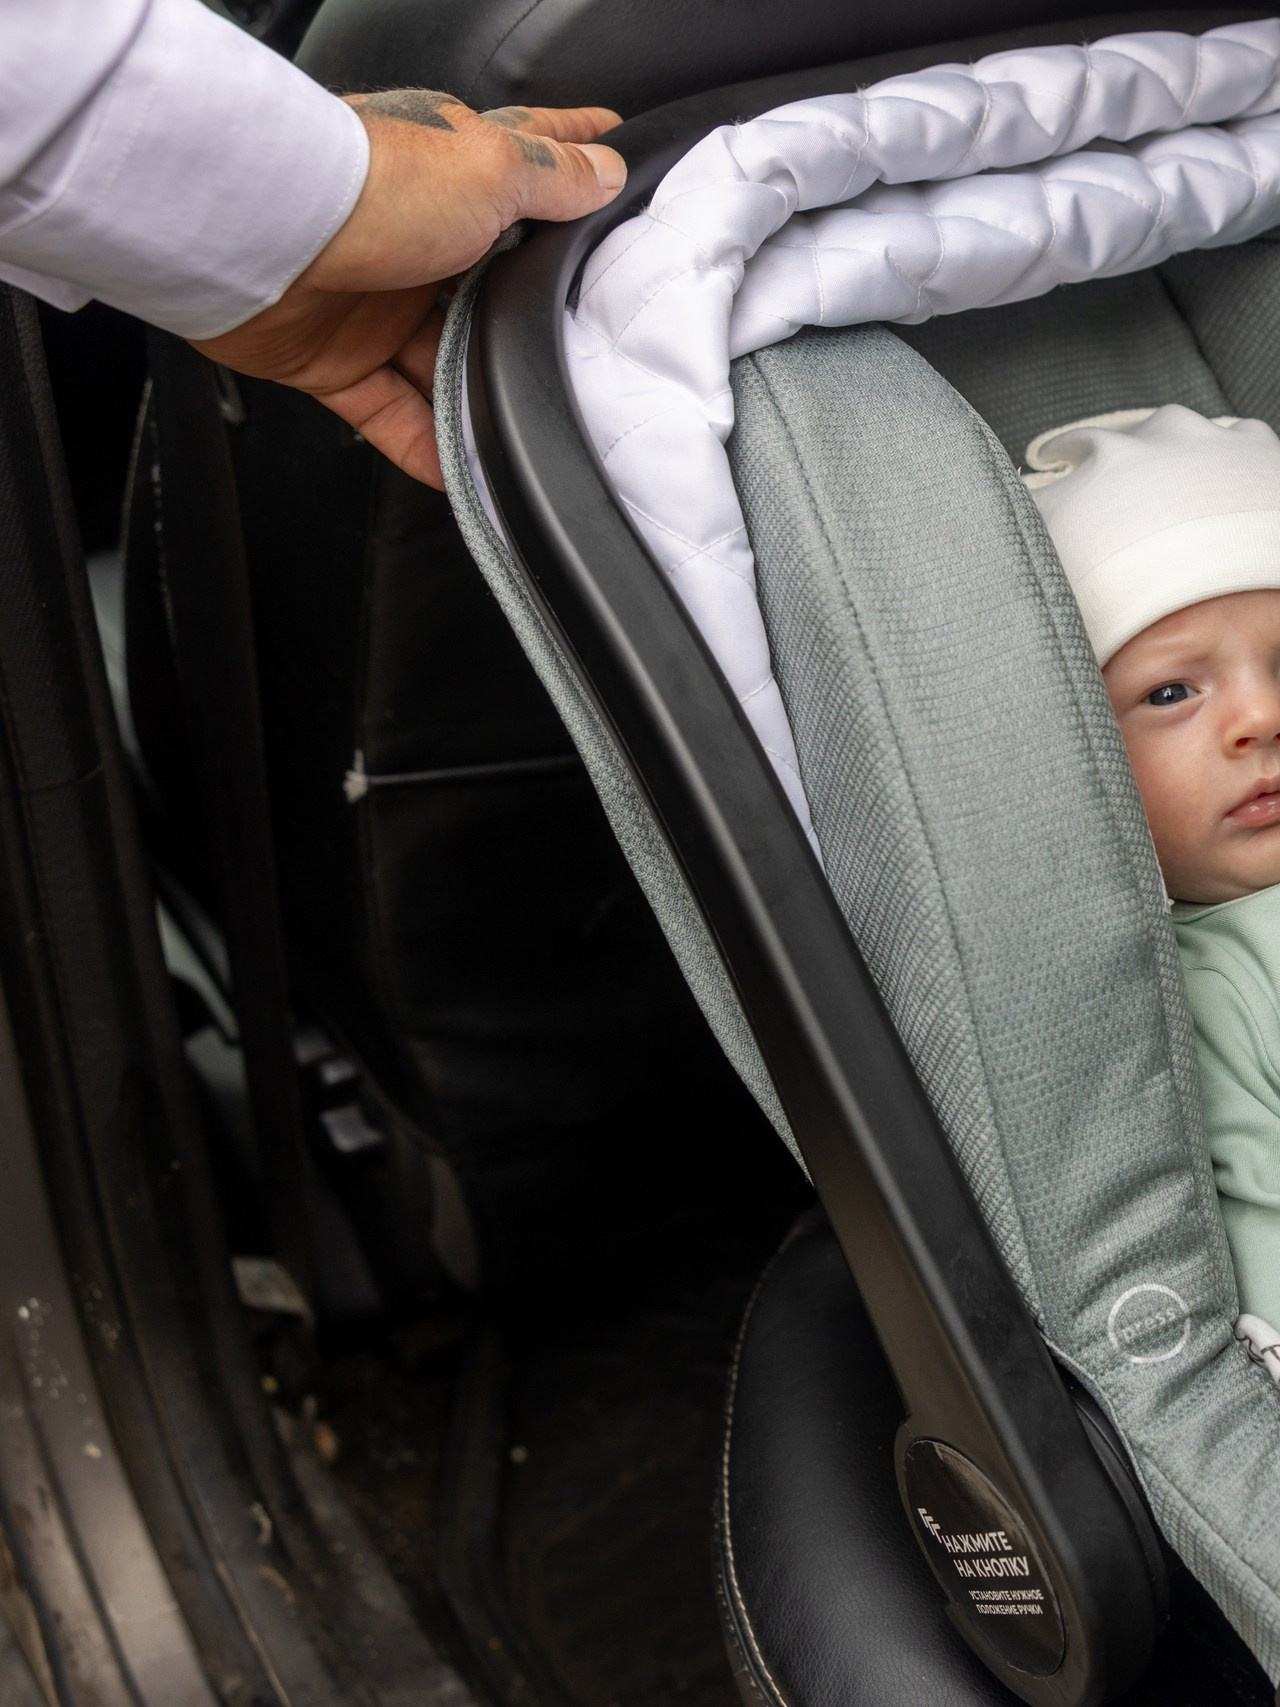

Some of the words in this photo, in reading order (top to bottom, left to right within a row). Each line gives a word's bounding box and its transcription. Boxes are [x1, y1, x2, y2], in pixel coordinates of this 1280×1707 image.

[941, 1531, 1013, 1553] НАЖМИТЕ
[953, 1559, 976, 1578] НА
[974, 1556, 1030, 1578] КНОПКУ
[968, 1590, 1013, 1601] УСТАНОВИТЕ
[1011, 1588, 1044, 1601] НУЖНОЕ
[976, 1604, 1020, 1615] ПОЛОЖЕНИЕ
[1018, 1604, 1044, 1615] РУЧКИ
